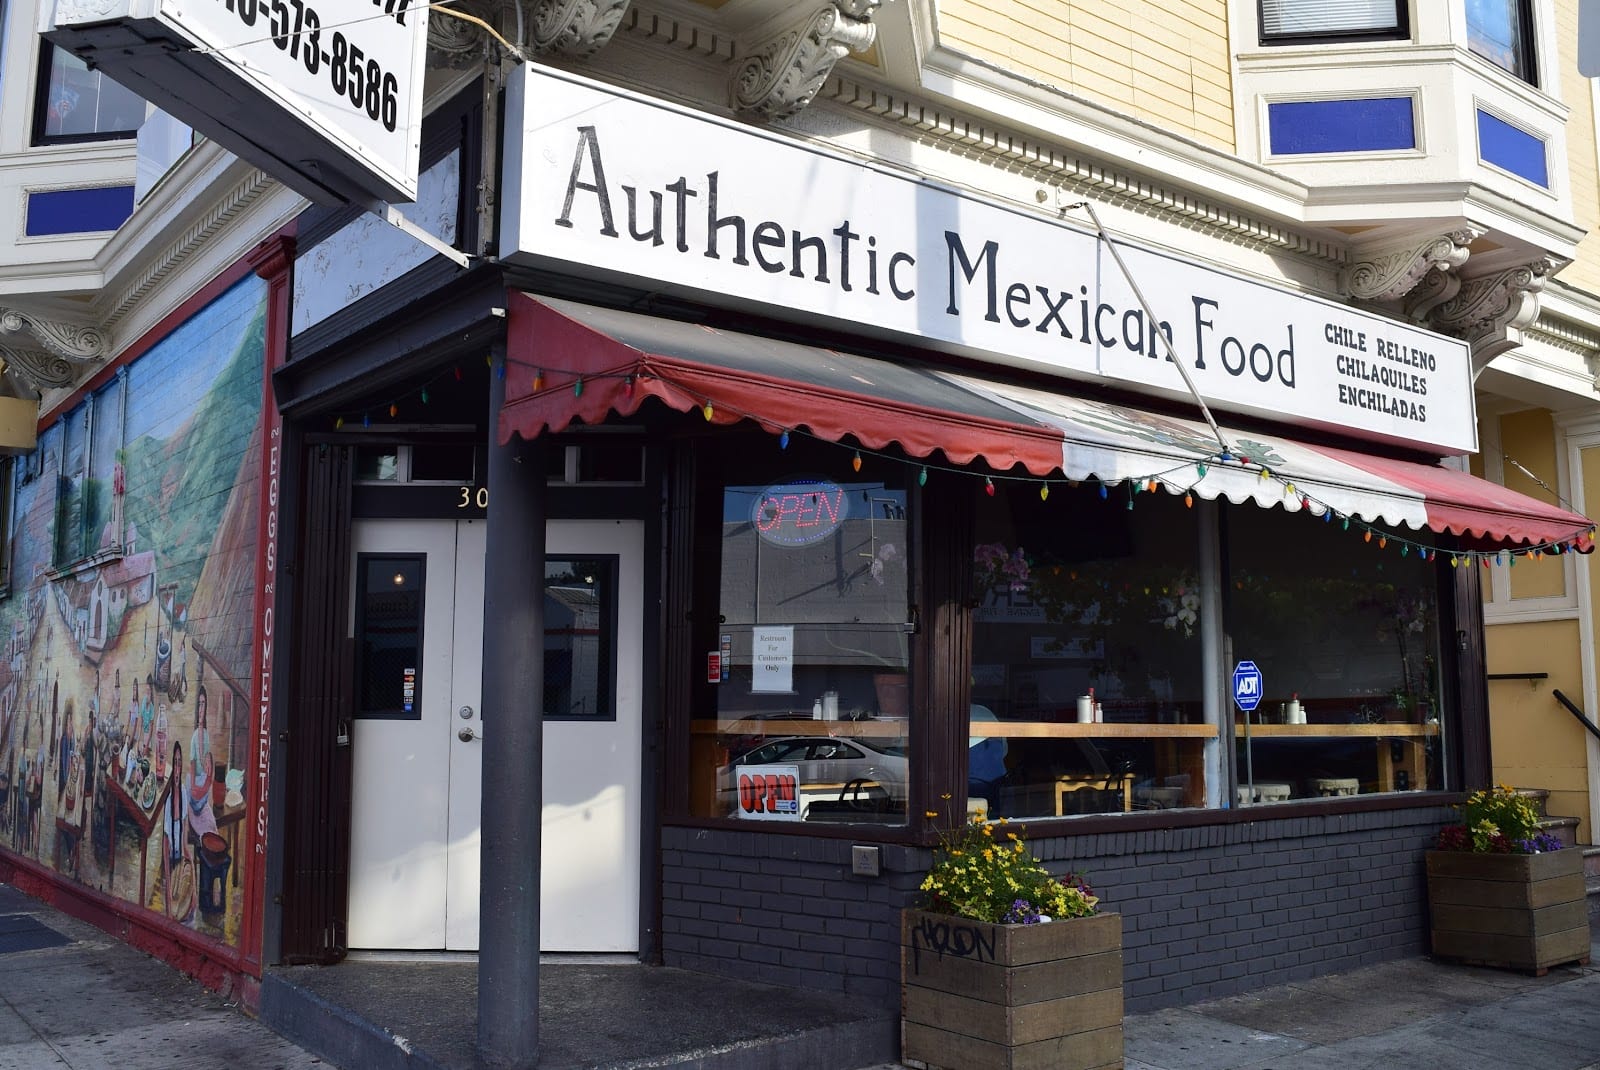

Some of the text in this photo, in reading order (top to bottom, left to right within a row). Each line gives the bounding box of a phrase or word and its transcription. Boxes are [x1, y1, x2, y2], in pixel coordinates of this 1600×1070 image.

[554, 125, 1297, 389] Authentic Mexican Food
[1324, 323, 1436, 372] CHILE RELLENO
[1336, 354, 1427, 396] CHILAQUILES
[1338, 383, 1426, 422] ENCHILADAS
[267, 446, 277, 572] EGGS
[757, 488, 843, 531] OPEN
[765, 664, 779, 673] Only
[1238, 676, 1258, 695] ADT
[740, 773, 796, 813] OPEN
